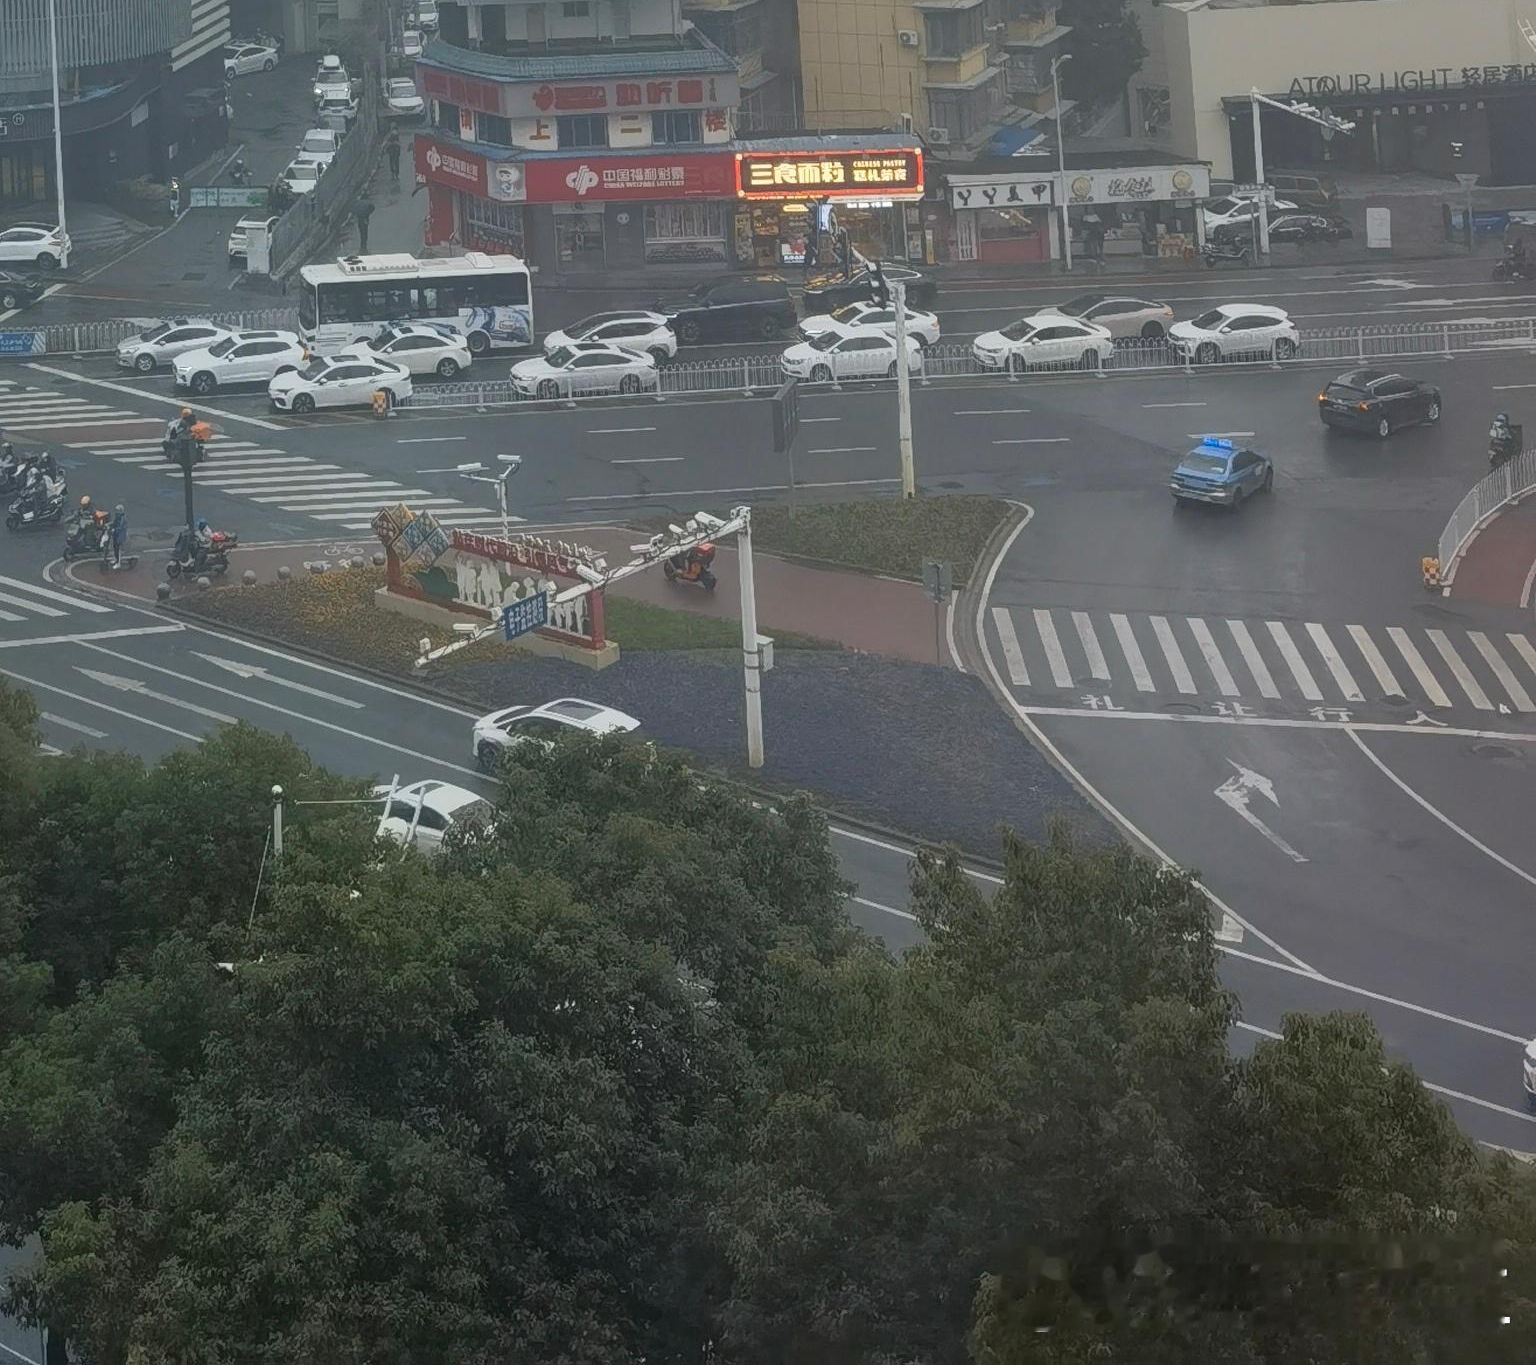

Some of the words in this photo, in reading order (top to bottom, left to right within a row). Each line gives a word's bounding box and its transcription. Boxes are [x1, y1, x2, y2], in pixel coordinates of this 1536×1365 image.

[1288, 73, 1371, 96] ATOUR
[1380, 68, 1453, 92] LIGHT
[603, 167, 685, 183] 中国福利彩票
